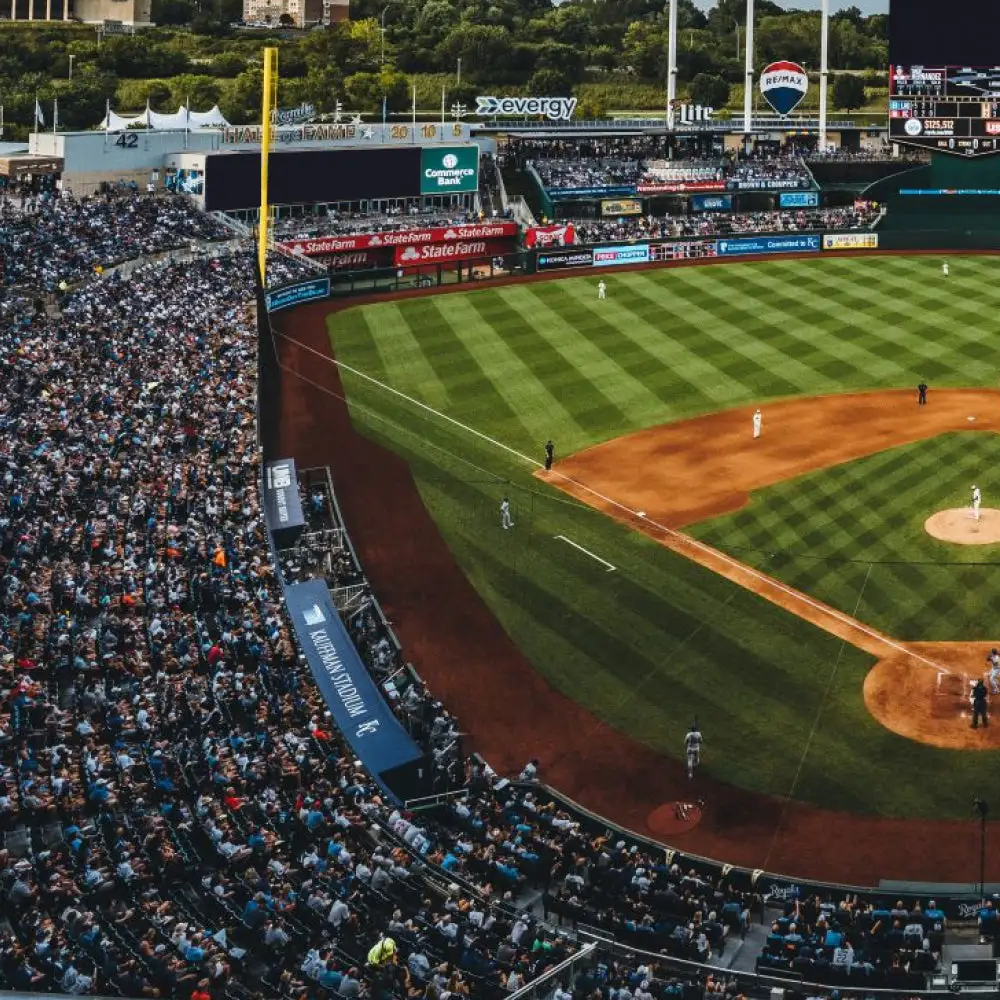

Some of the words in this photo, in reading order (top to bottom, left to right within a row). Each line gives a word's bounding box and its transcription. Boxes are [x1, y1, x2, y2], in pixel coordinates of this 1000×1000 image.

[767, 75, 802, 85] RE/MAX
[502, 99, 575, 119] evergy
[680, 104, 714, 125] Lite
[302, 126, 355, 141] FAME
[391, 126, 408, 138] 20
[423, 125, 436, 138] 10
[453, 124, 461, 137] 5
[116, 134, 138, 148] 42
[425, 168, 474, 178] Commerce
[437, 176, 462, 185] Bank
[547, 256, 568, 264] KONICA
[569, 253, 593, 261] MINOLTA
[273, 465, 291, 488] UMB
[310, 629, 345, 673] KAUFFMAN
[332, 669, 368, 718] STADIUM
